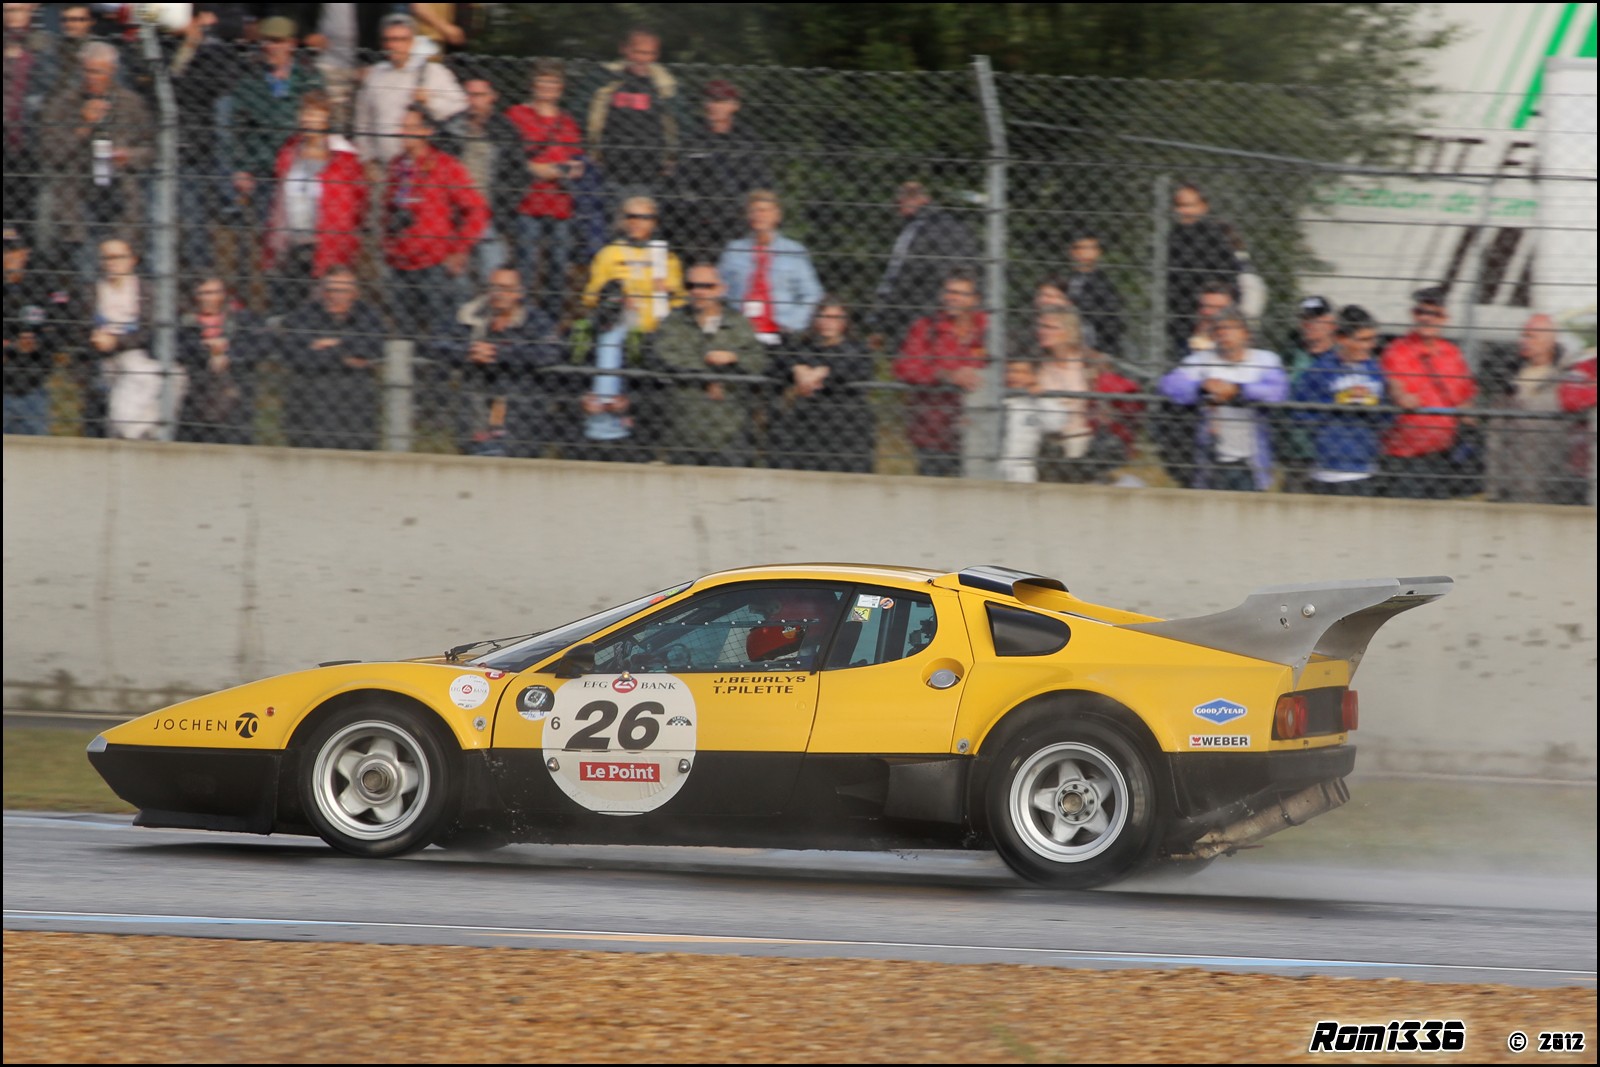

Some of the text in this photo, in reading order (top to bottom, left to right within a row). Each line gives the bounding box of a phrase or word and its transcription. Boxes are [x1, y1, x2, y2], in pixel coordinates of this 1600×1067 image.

[583, 680, 677, 690] EFG BANK
[713, 675, 807, 684] J.BEURLYS
[713, 685, 794, 694] T.PILETTE
[153, 713, 260, 739] JOCHEN 70
[550, 716, 561, 730] 6
[562, 700, 665, 753] 26
[1202, 736, 1248, 746] WEBER
[586, 764, 655, 780] Le Point
